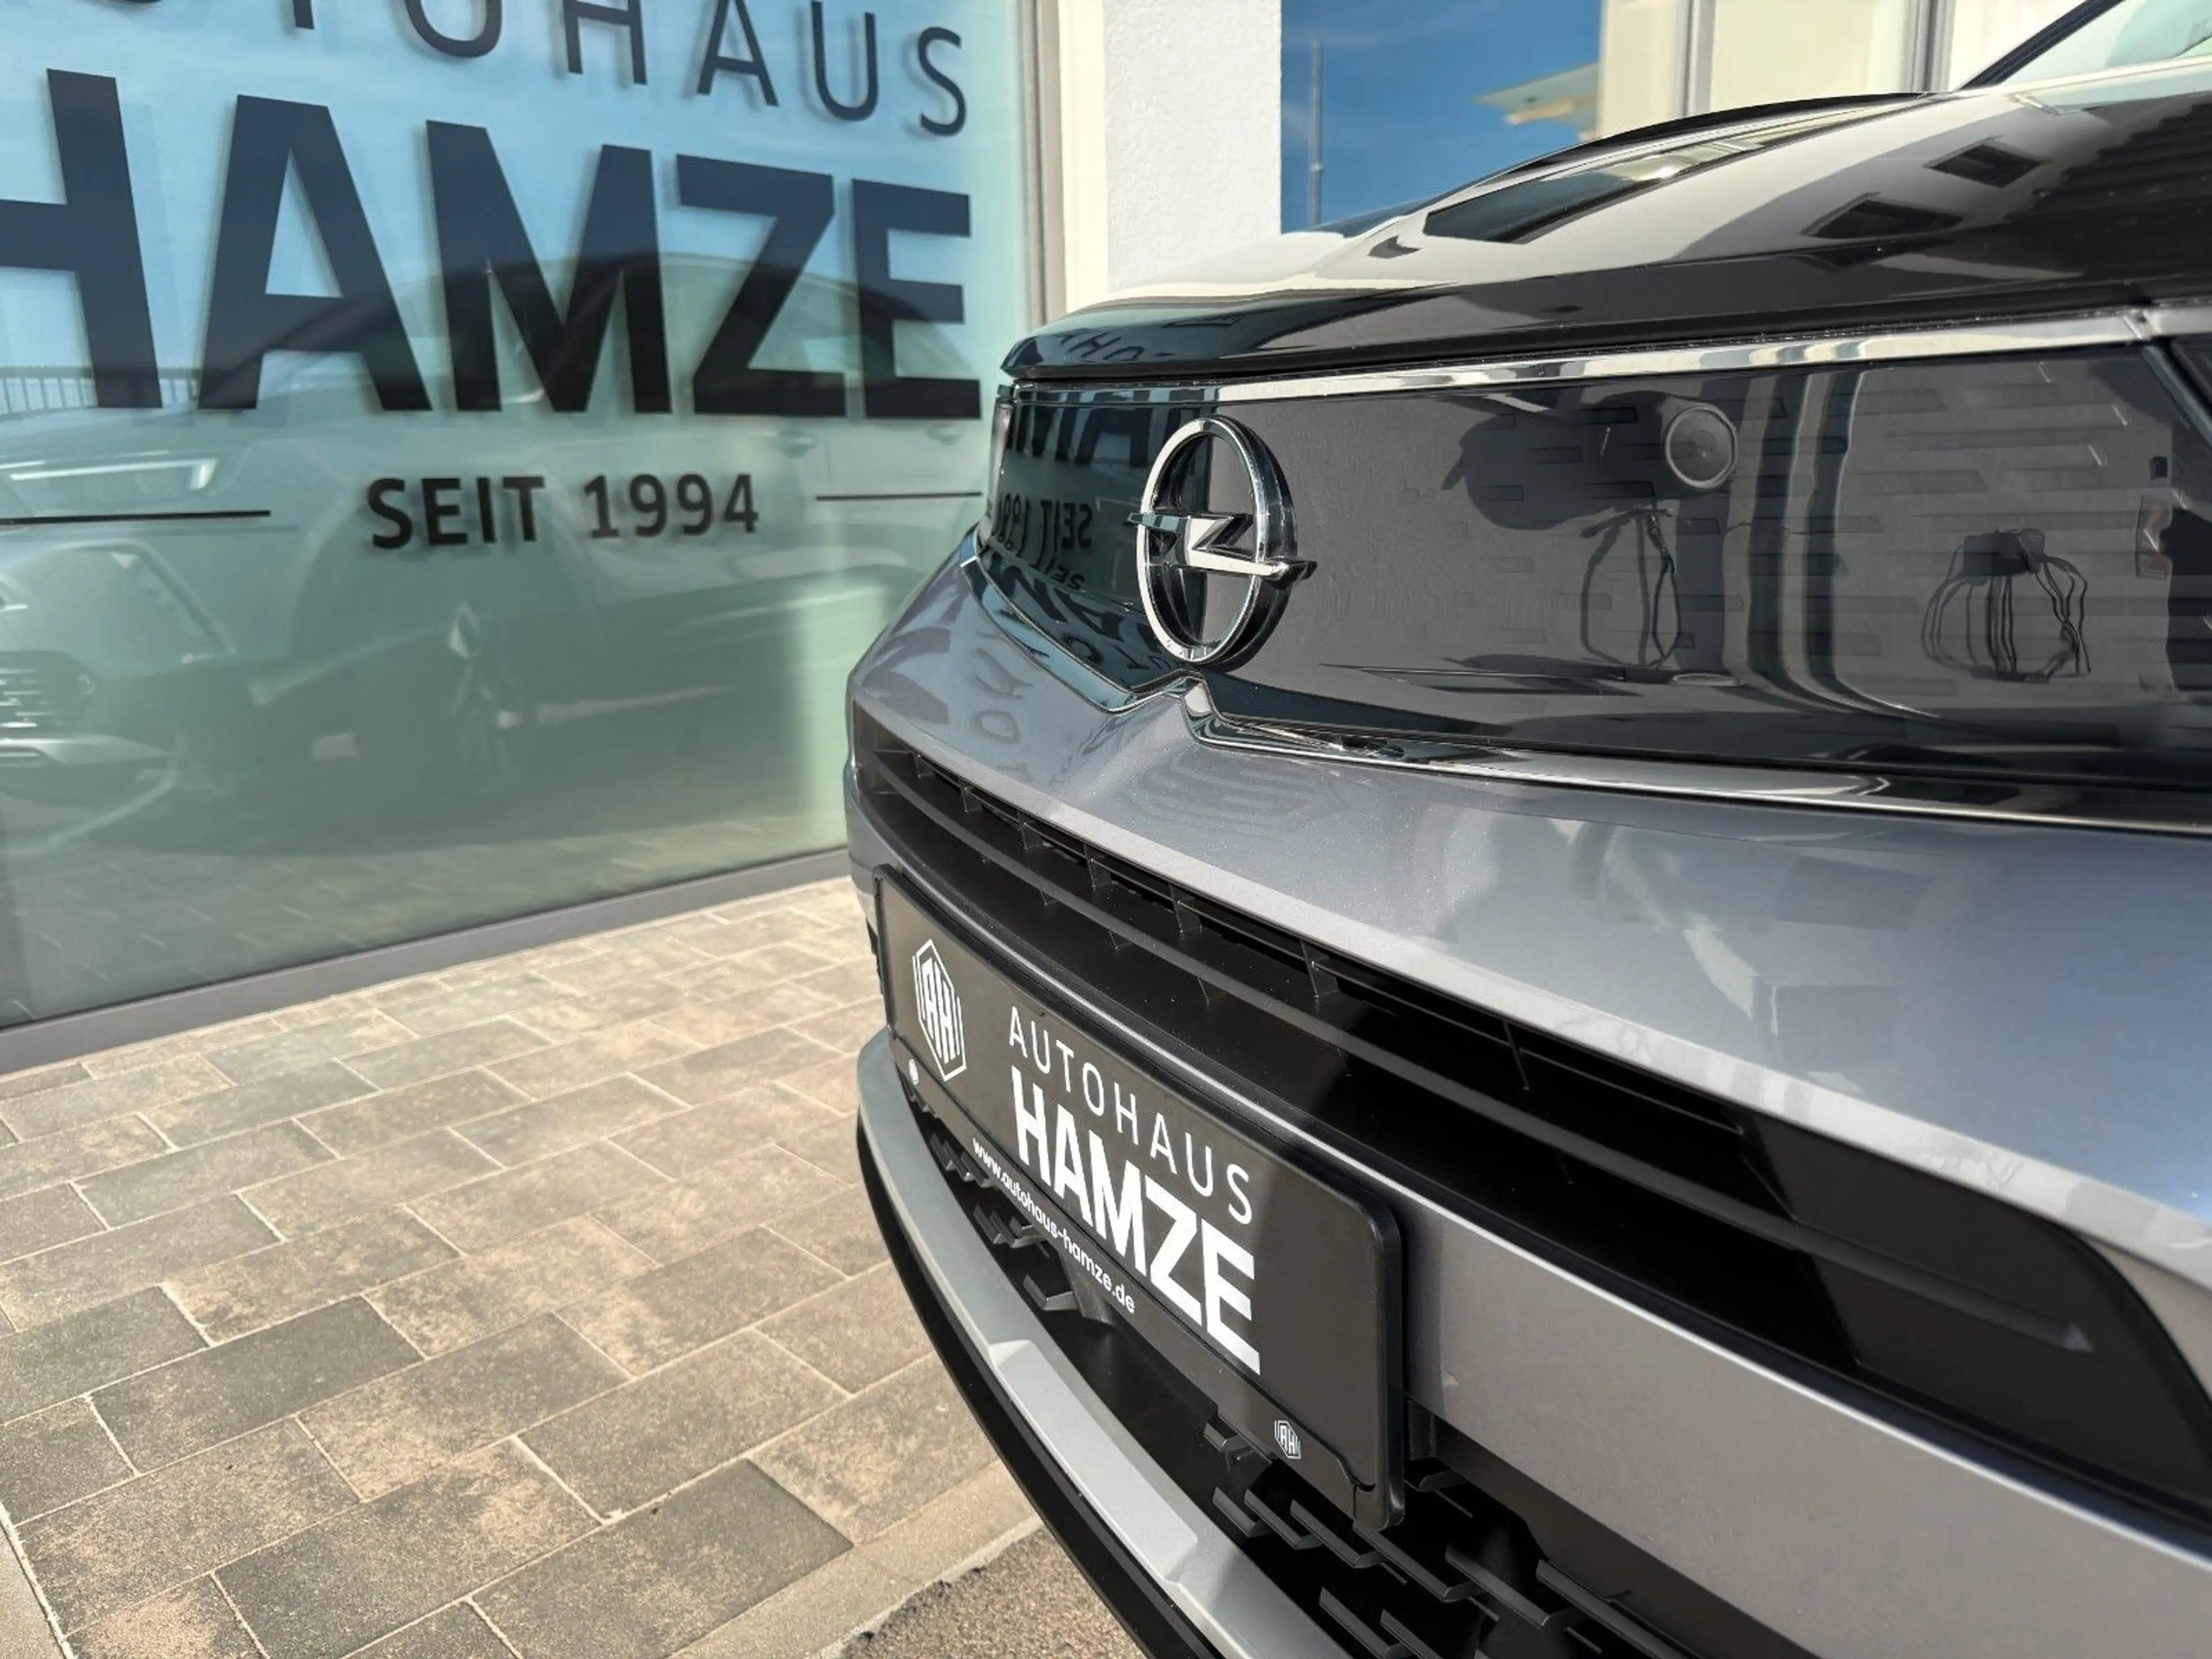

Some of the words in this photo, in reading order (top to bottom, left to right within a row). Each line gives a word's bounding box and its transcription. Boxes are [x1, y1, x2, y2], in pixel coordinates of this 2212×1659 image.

[367, 476, 545, 549] SEIT
[583, 473, 759, 539] 1994
[1009, 1006, 1252, 1224] AUTOHAUS
[973, 1137, 1135, 1314] www.autohaus-hamze.de
[1012, 1065, 1260, 1376] HAMZE
